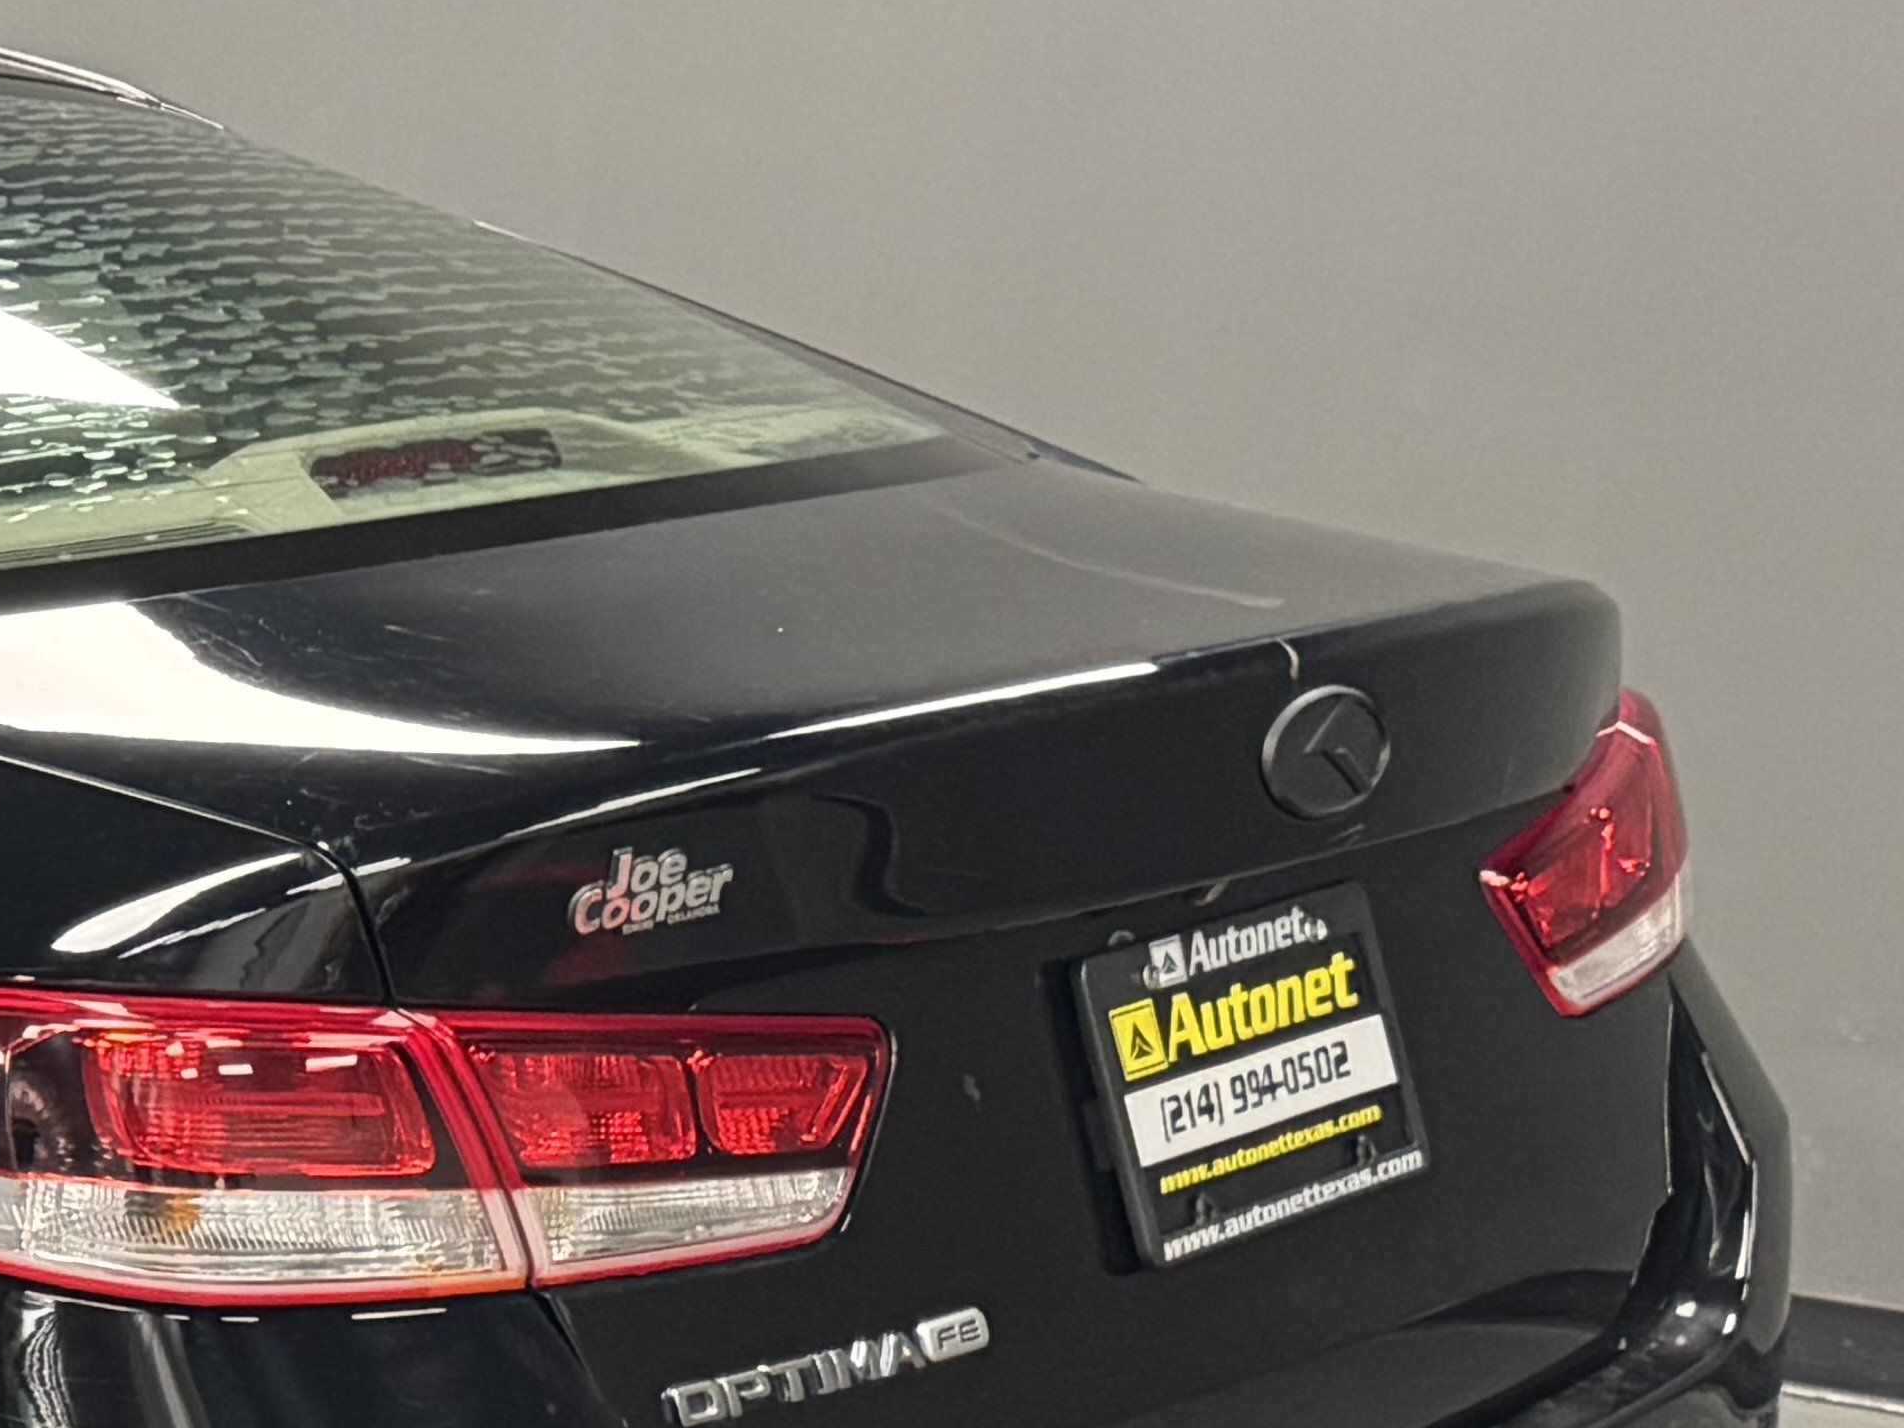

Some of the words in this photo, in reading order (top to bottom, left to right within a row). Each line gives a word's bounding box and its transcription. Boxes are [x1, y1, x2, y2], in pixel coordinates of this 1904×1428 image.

[567, 863, 733, 935] Cooper
[606, 846, 688, 899] Joe
[1189, 905, 1307, 976] Autonet
[1167, 952, 1360, 1062] Autonet
[1160, 1081, 1224, 1142] (214)
[1229, 1040, 1352, 1114] 994-0502
[1159, 1104, 1383, 1195] www.autonettexas.com
[1163, 1150, 1423, 1261] www.autonettexas.com
[660, 1331, 927, 1427] OPTIMA
